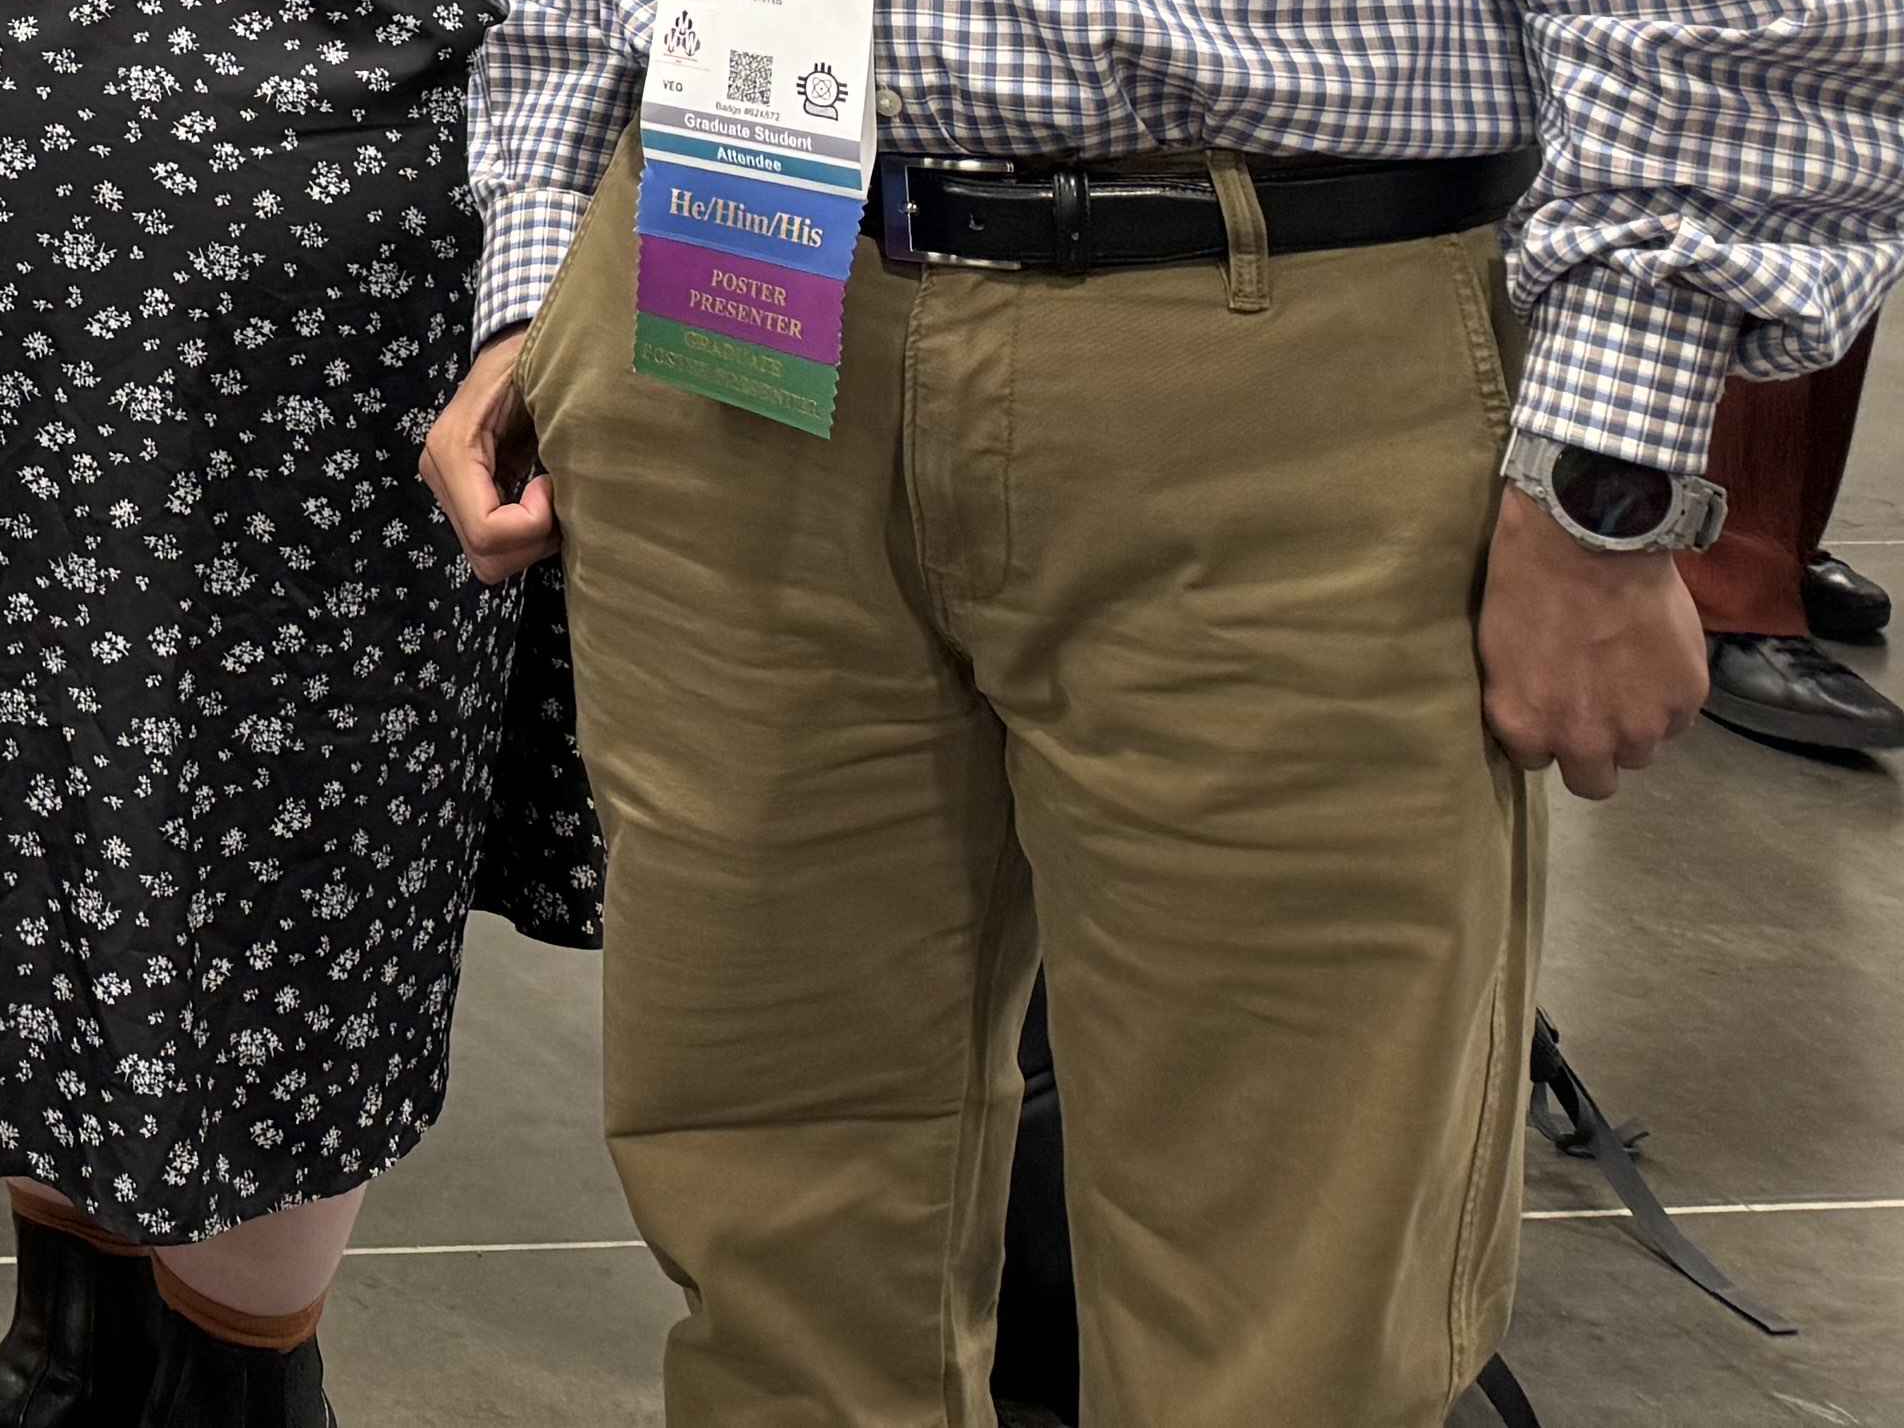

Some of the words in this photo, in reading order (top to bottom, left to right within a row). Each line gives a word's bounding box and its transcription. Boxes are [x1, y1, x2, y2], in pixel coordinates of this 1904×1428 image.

[683, 113, 751, 138] Graduate
[754, 127, 813, 151] Student
[717, 147, 782, 172] Attendee
[669, 188, 824, 248] He/Him/His
[711, 269, 787, 307] POSTER
[689, 289, 802, 340] PRESENTER
